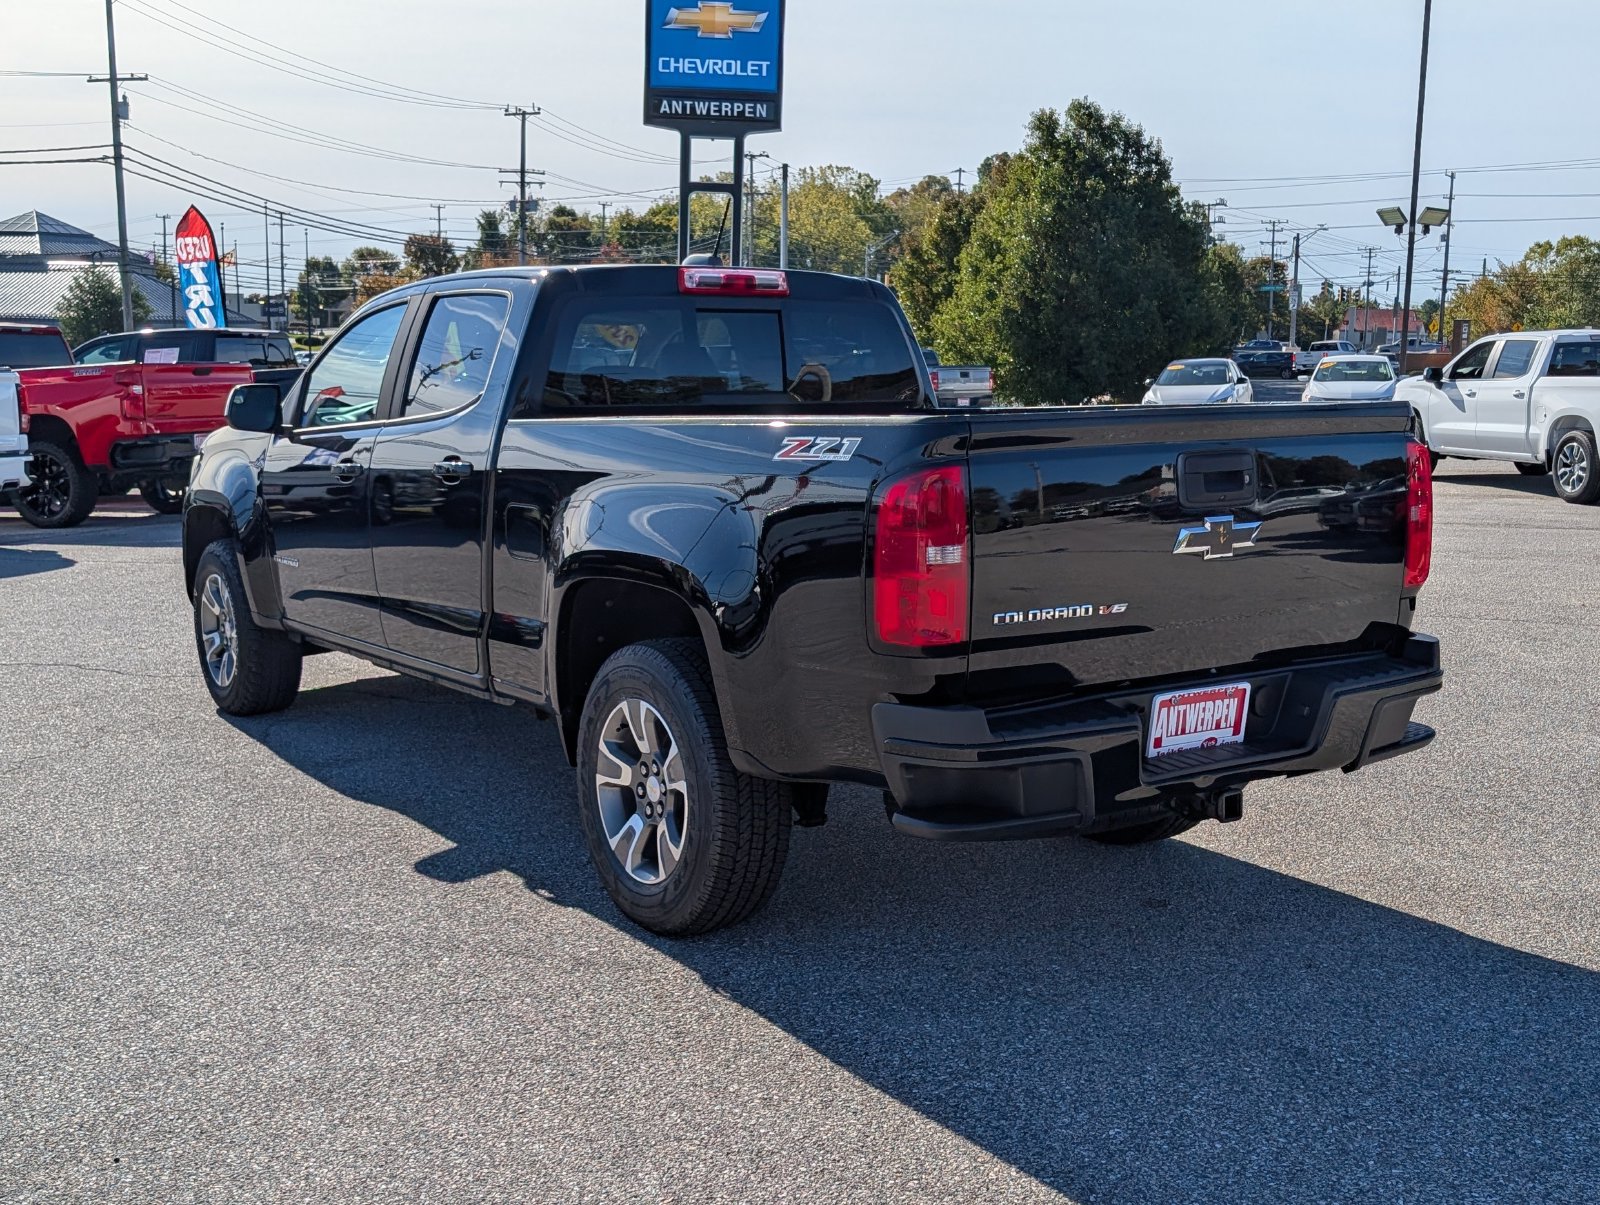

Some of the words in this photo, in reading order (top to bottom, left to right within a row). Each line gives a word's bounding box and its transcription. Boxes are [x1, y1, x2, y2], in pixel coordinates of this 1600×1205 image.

[658, 57, 770, 77] CHEVROLET
[660, 100, 767, 118] ANTWERPEN
[772, 436, 863, 461] Z71
[993, 604, 1093, 625] COLORADO
[1098, 603, 1129, 615] V6
[1155, 698, 1238, 738] ANTWERPEN
